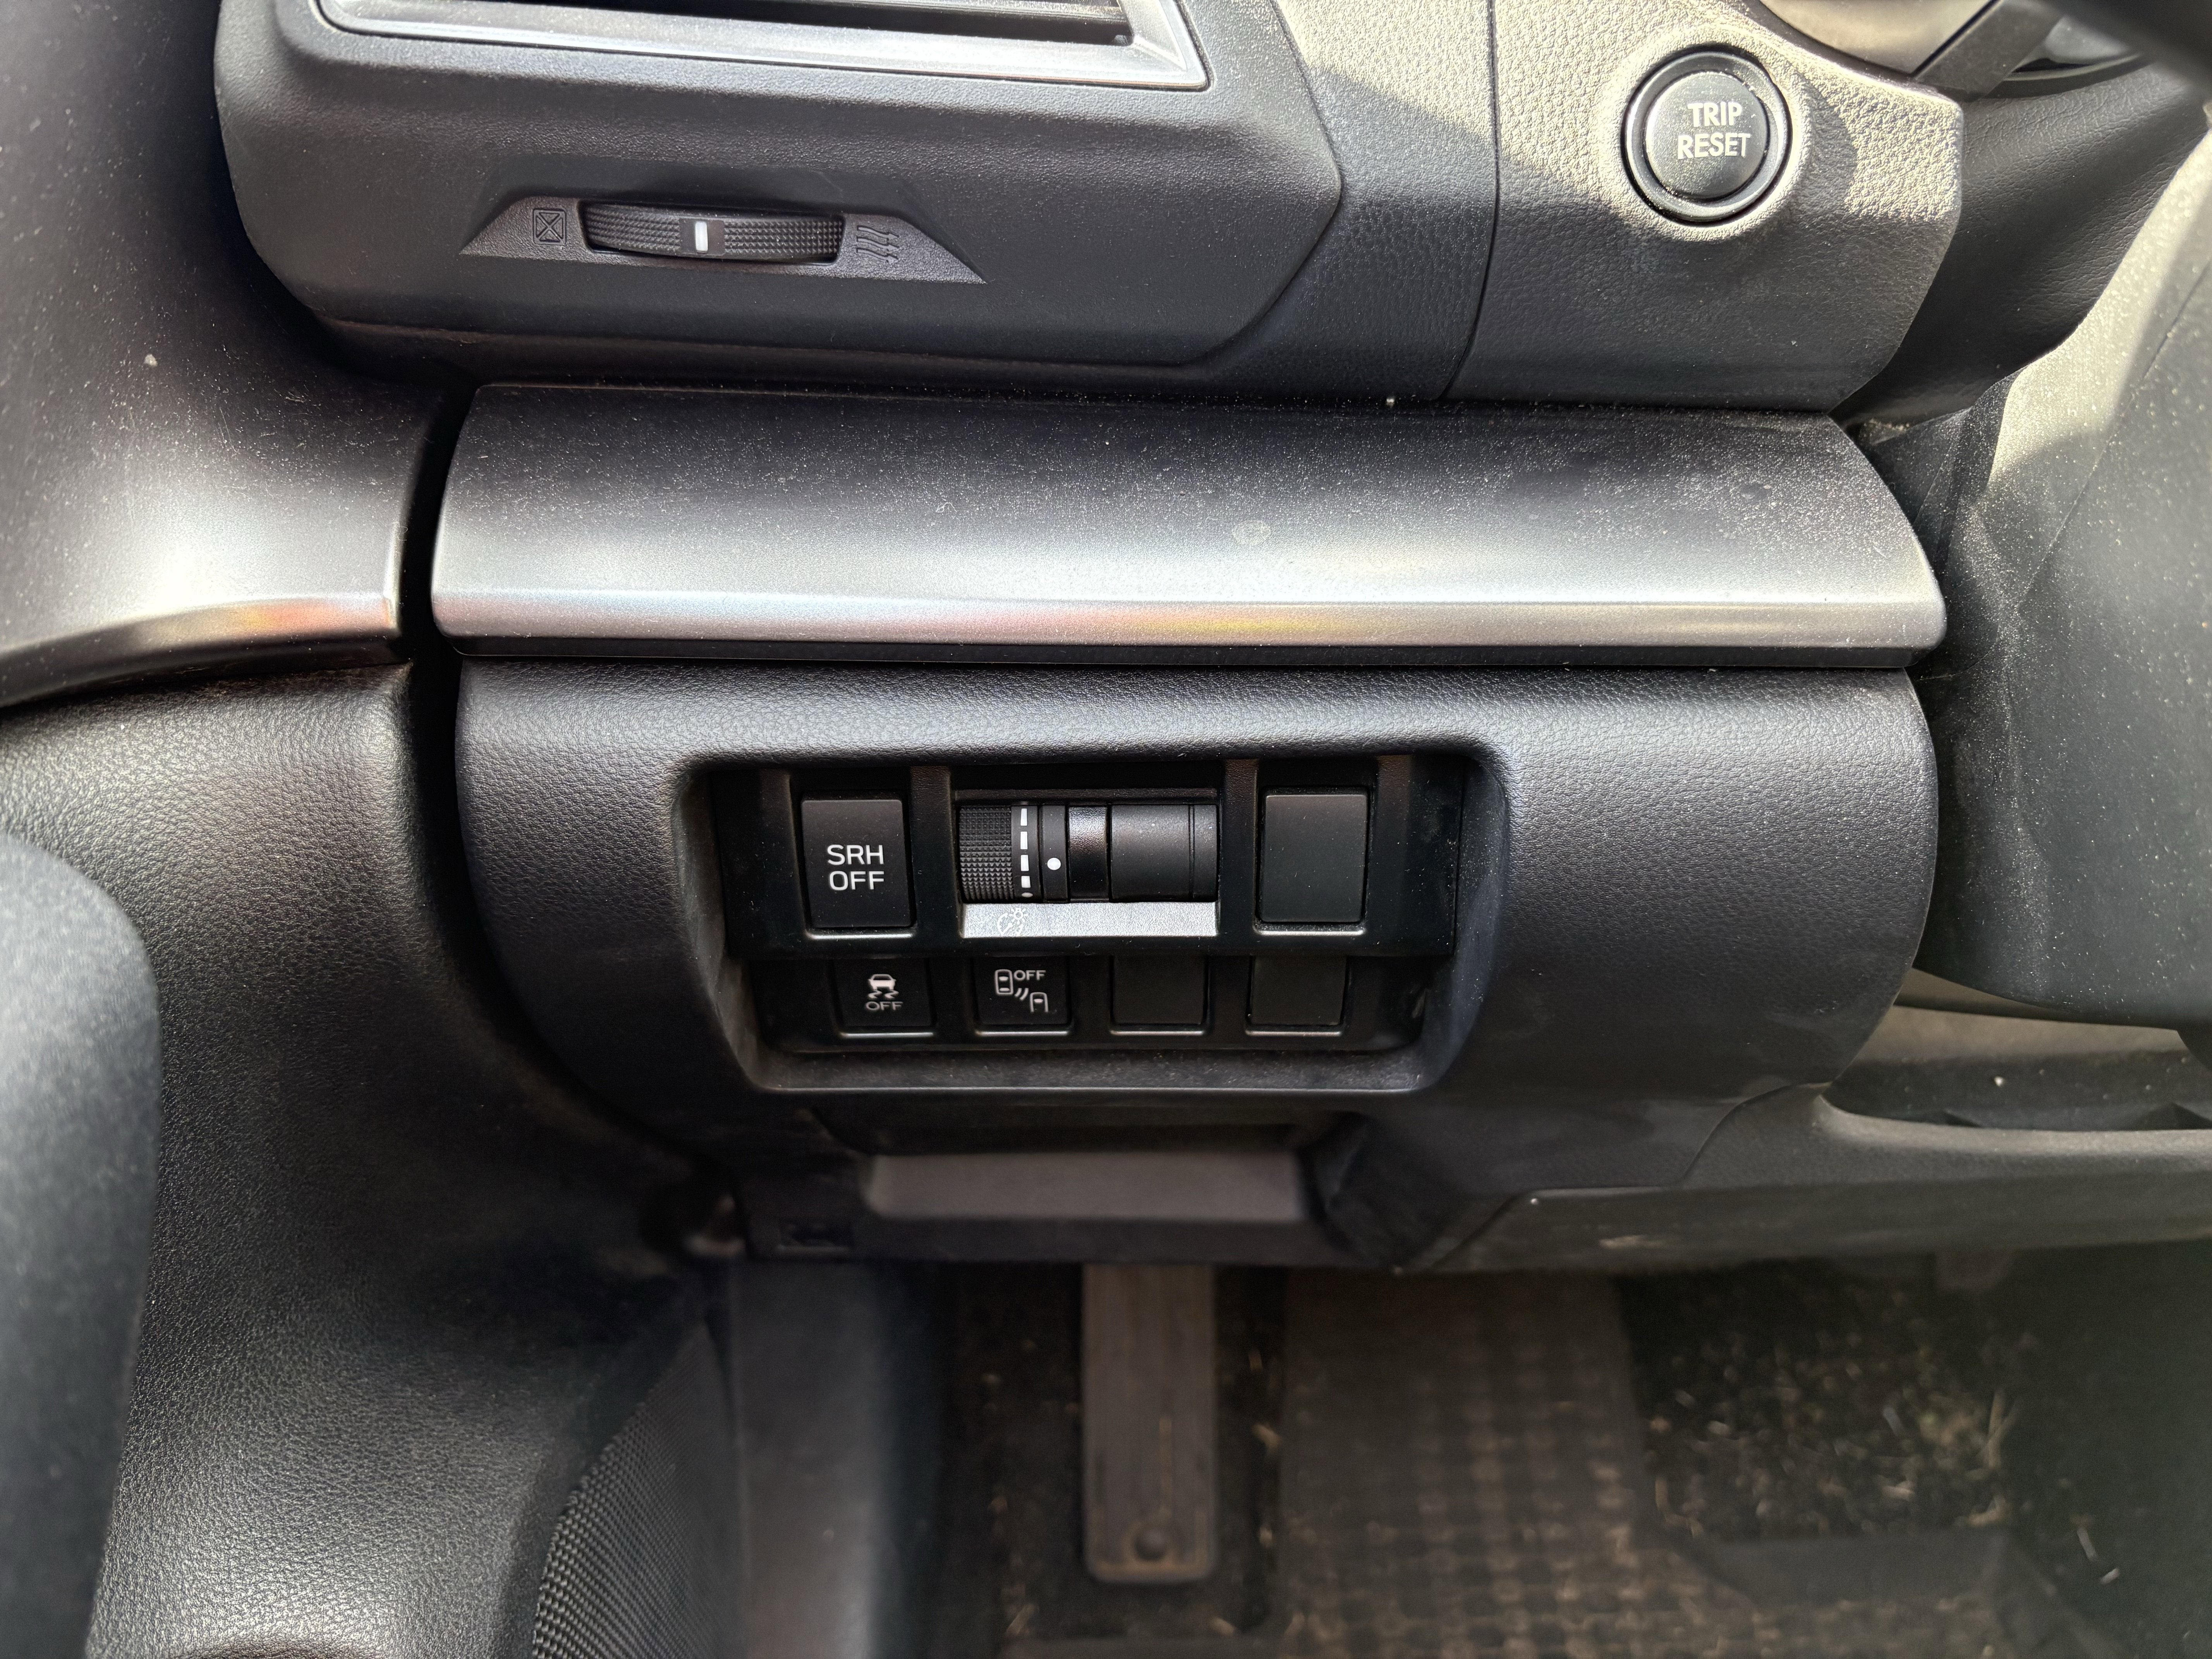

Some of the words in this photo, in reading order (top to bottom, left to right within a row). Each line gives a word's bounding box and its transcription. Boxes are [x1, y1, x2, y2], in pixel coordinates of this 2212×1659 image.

[1688, 102, 1742, 127] TRIP
[1678, 133, 1751, 159] RESET
[827, 845, 884, 865] SRH
[829, 871, 884, 891] OFF
[1014, 970, 1046, 980] OFF
[866, 1001, 903, 1011] OFF
